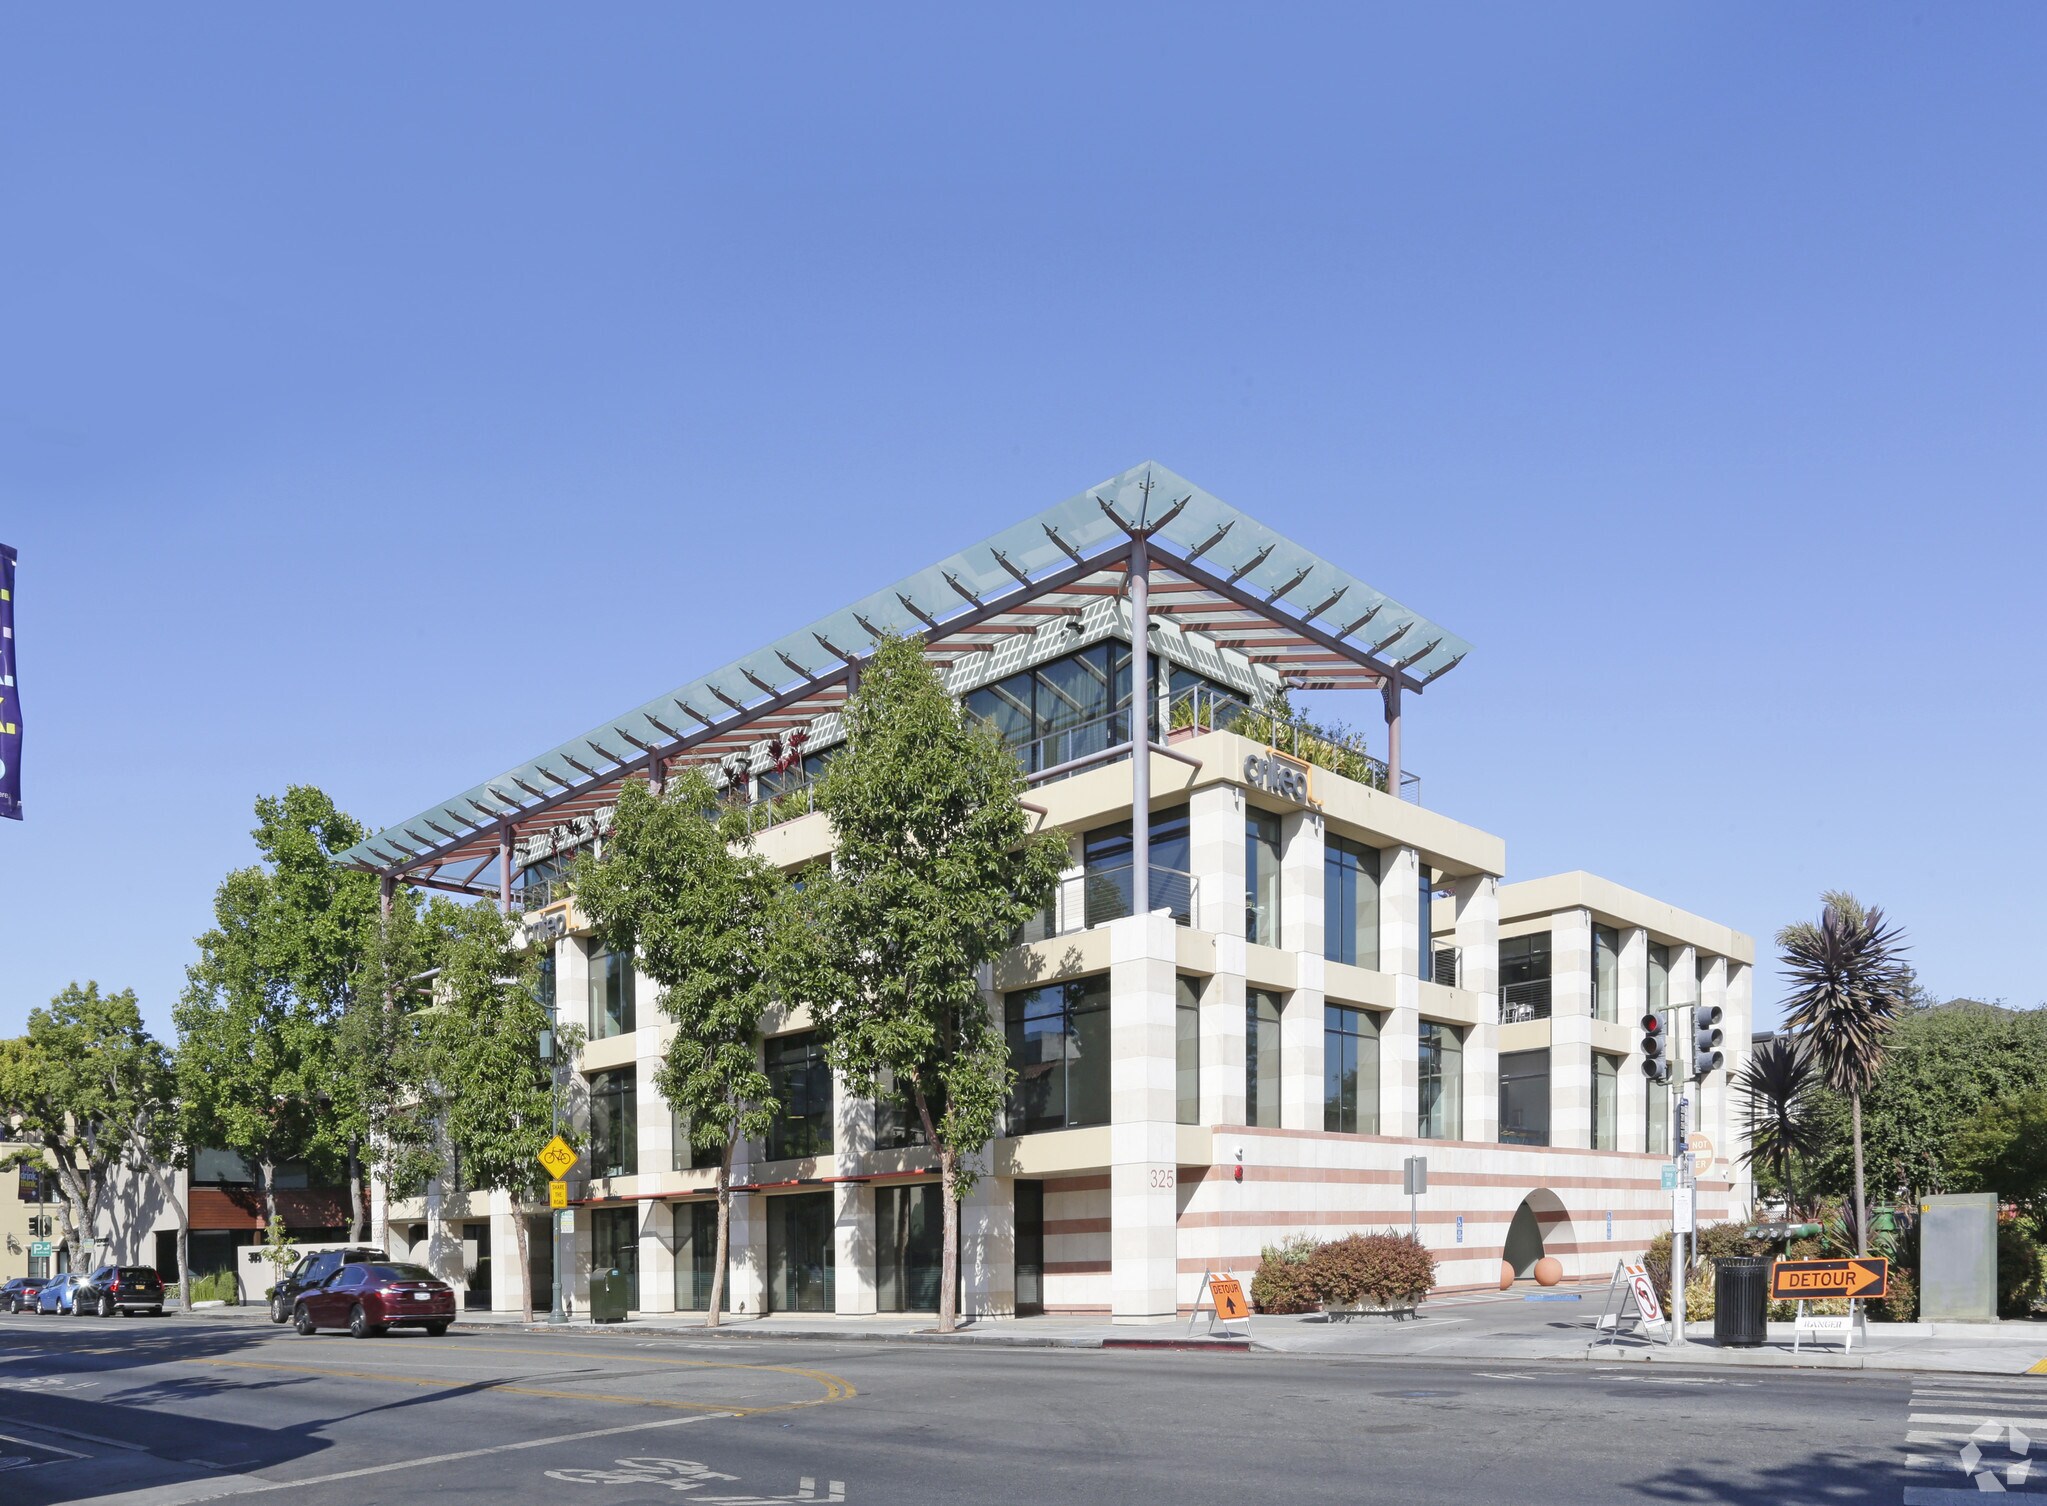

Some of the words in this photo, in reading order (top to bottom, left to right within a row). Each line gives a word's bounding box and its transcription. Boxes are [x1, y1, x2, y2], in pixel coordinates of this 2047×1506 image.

[1244, 754, 1307, 800] criteo
[1692, 1140, 1708, 1149] NOT
[1150, 1169, 1174, 1188] 325
[1789, 1271, 1857, 1287] DETOUR
[1212, 1283, 1240, 1295] DETOUR
